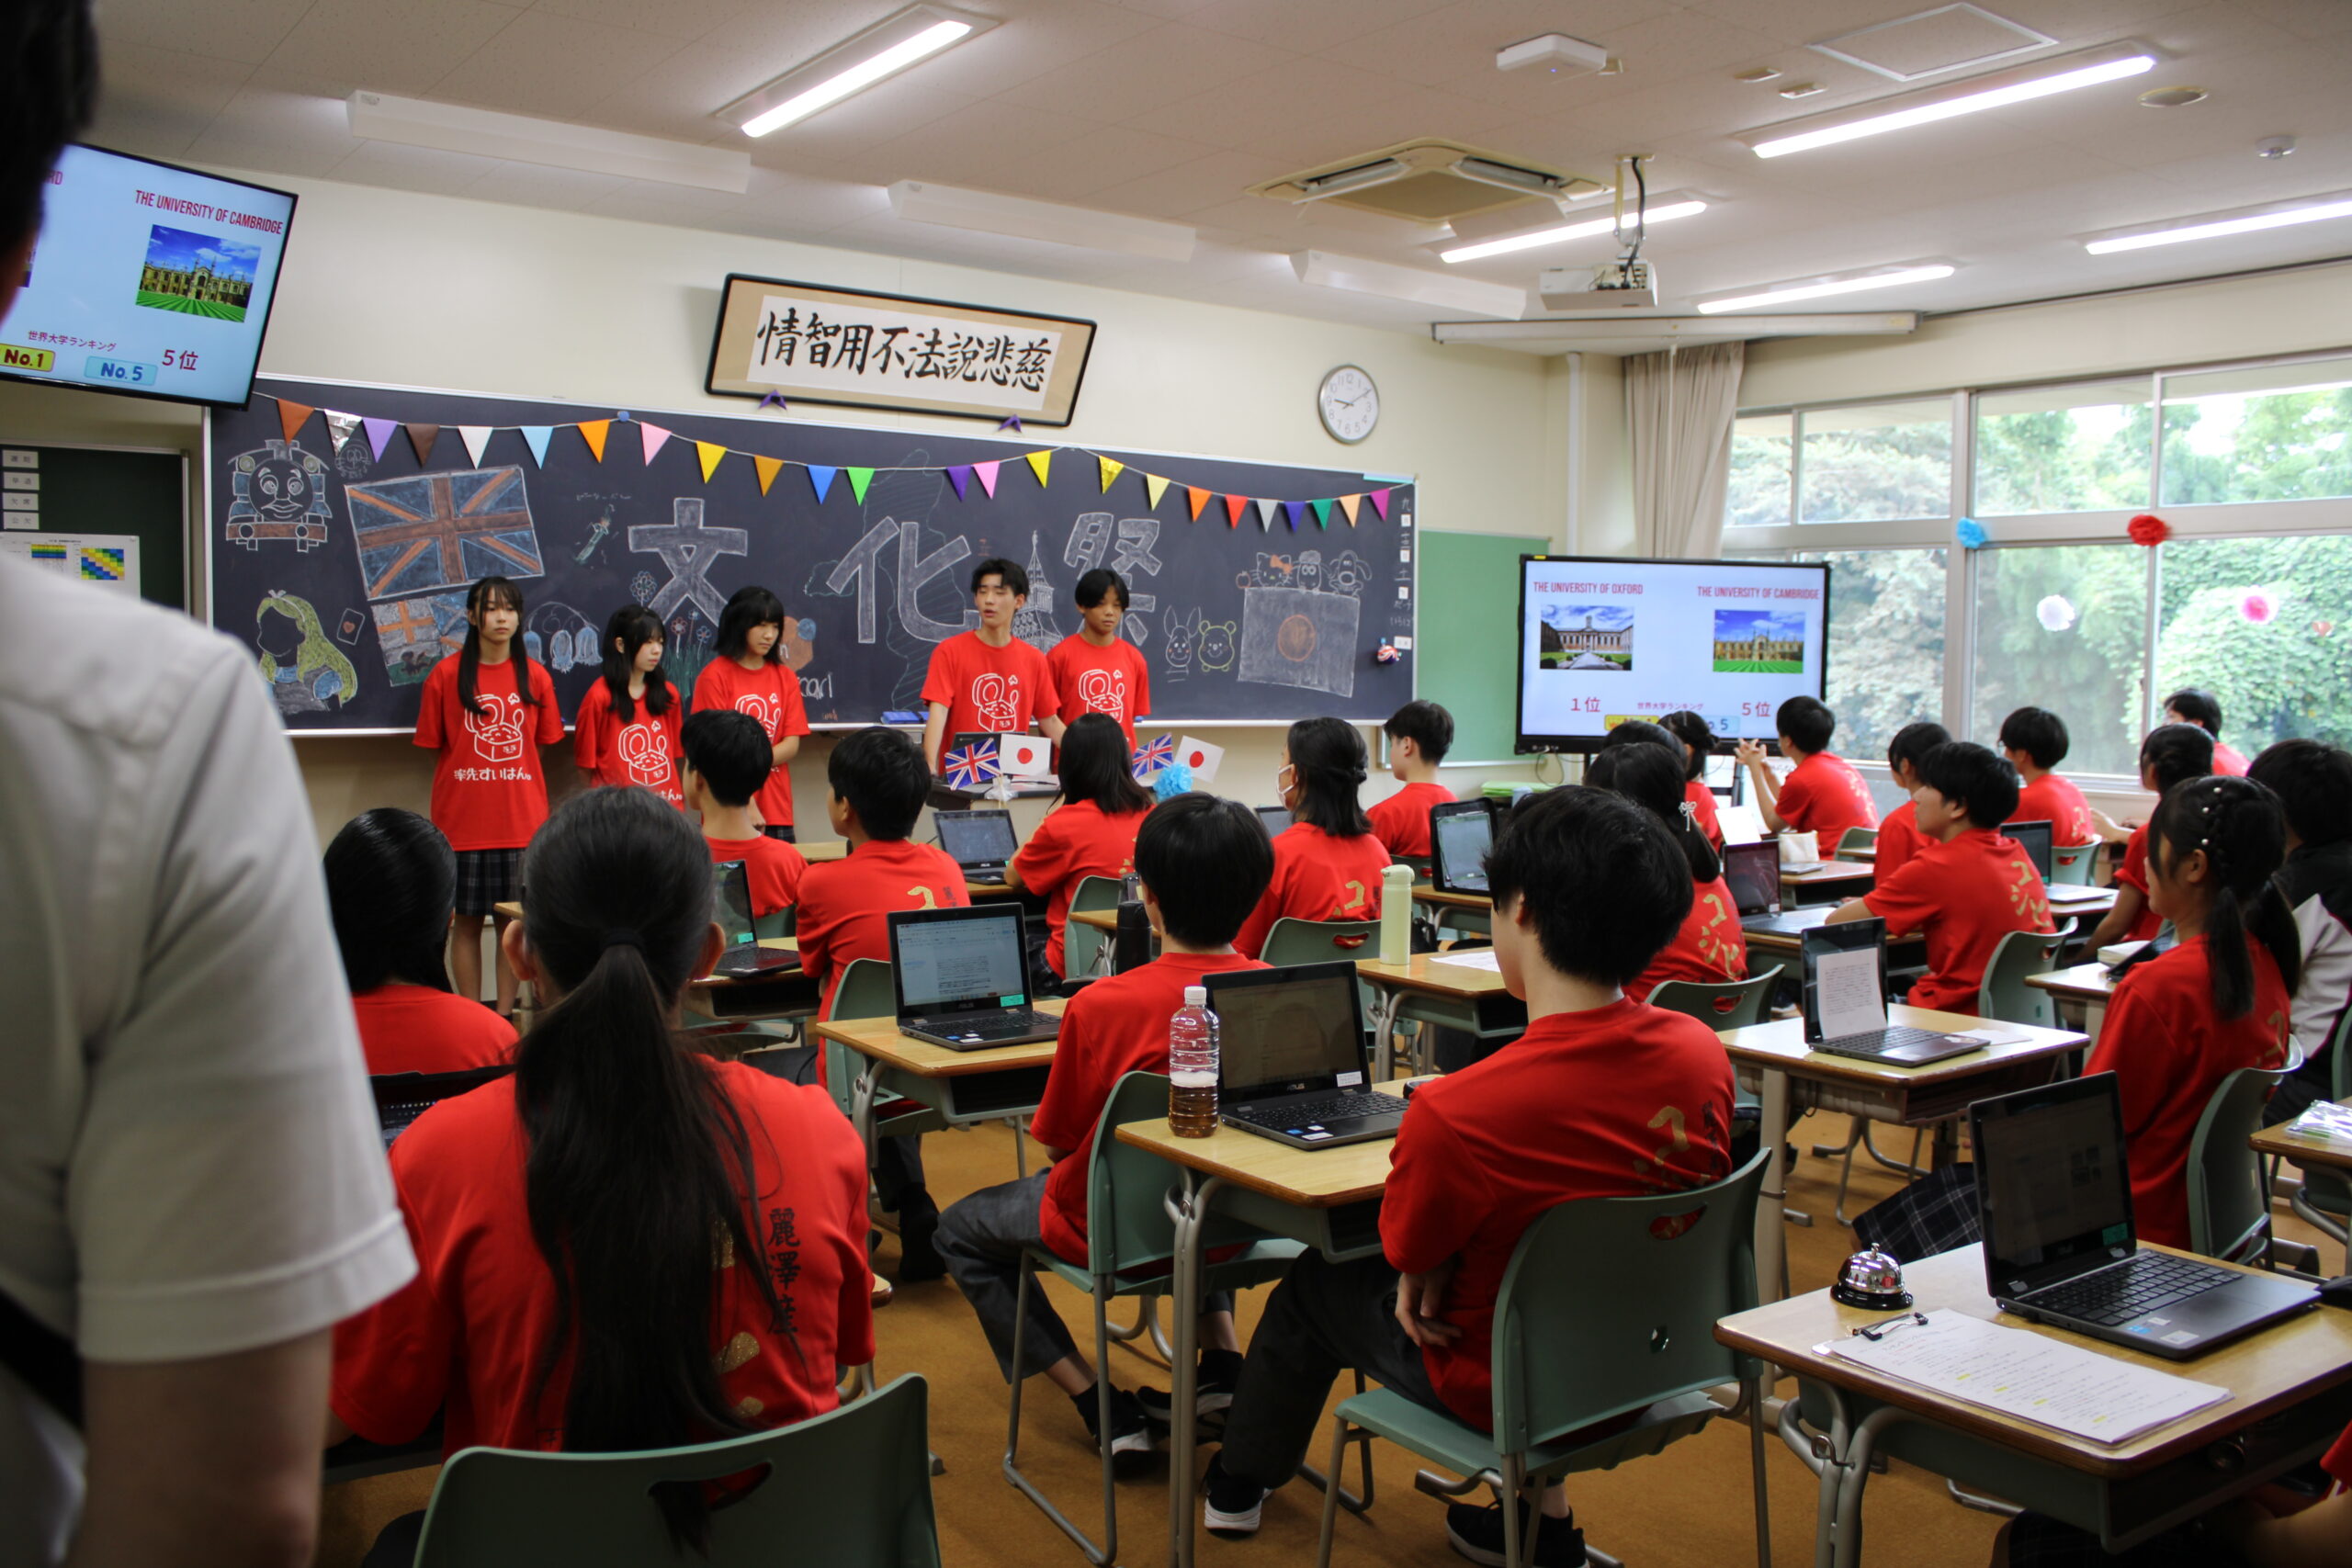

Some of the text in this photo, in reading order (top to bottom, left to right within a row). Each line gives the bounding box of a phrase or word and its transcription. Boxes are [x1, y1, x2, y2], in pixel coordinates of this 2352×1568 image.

[135, 189, 284, 235] THE UNIVERSITY OF CAMBRIDGE
[28, 331, 117, 352] 世界大学ランキング
[4, 349, 45, 367] No.1
[1533, 581, 1644, 595] THE UNIVERSITY OF OXFORD
[1697, 586, 1820, 599] THE UNIVERSITY OF CAMBRIDGE
[1570, 696, 1601, 713] 1位
[1637, 702, 1704, 711] 世界大学ランキング
[1741, 701, 1771, 717] 5位
